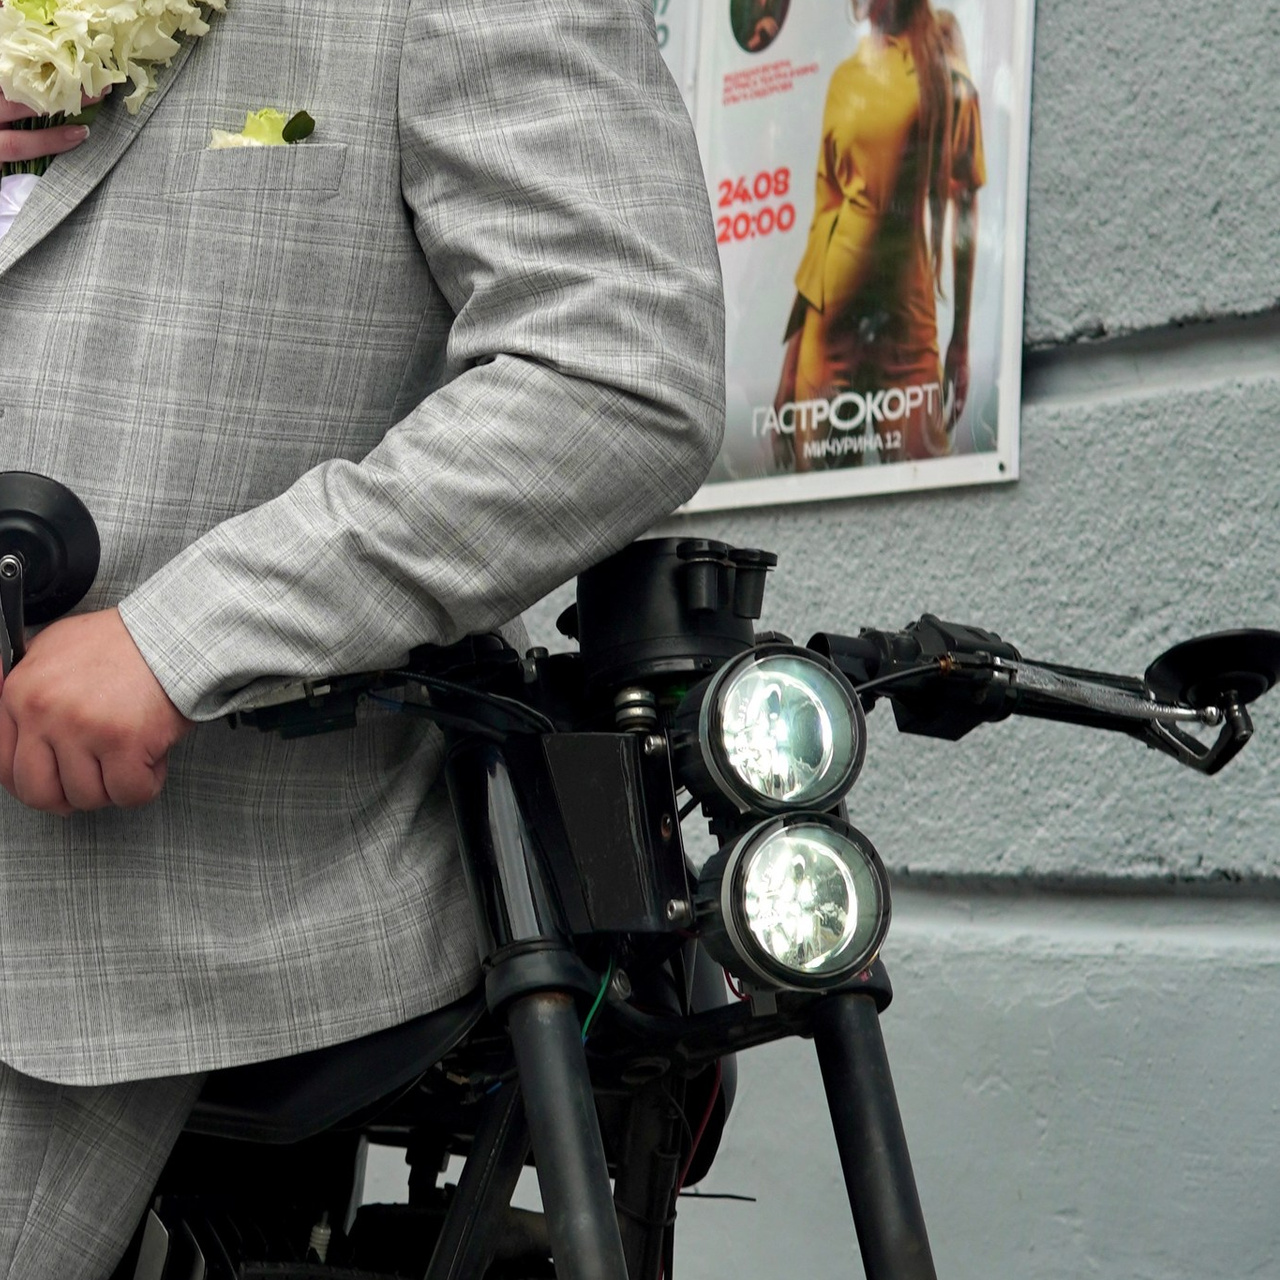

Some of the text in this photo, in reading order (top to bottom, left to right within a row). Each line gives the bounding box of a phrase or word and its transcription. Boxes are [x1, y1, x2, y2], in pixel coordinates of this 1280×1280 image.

[716, 203, 796, 245] 20:00
[751, 382, 940, 437] ГАСТРОКОРТ
[802, 430, 902, 460] МИЧУРИНА 12
